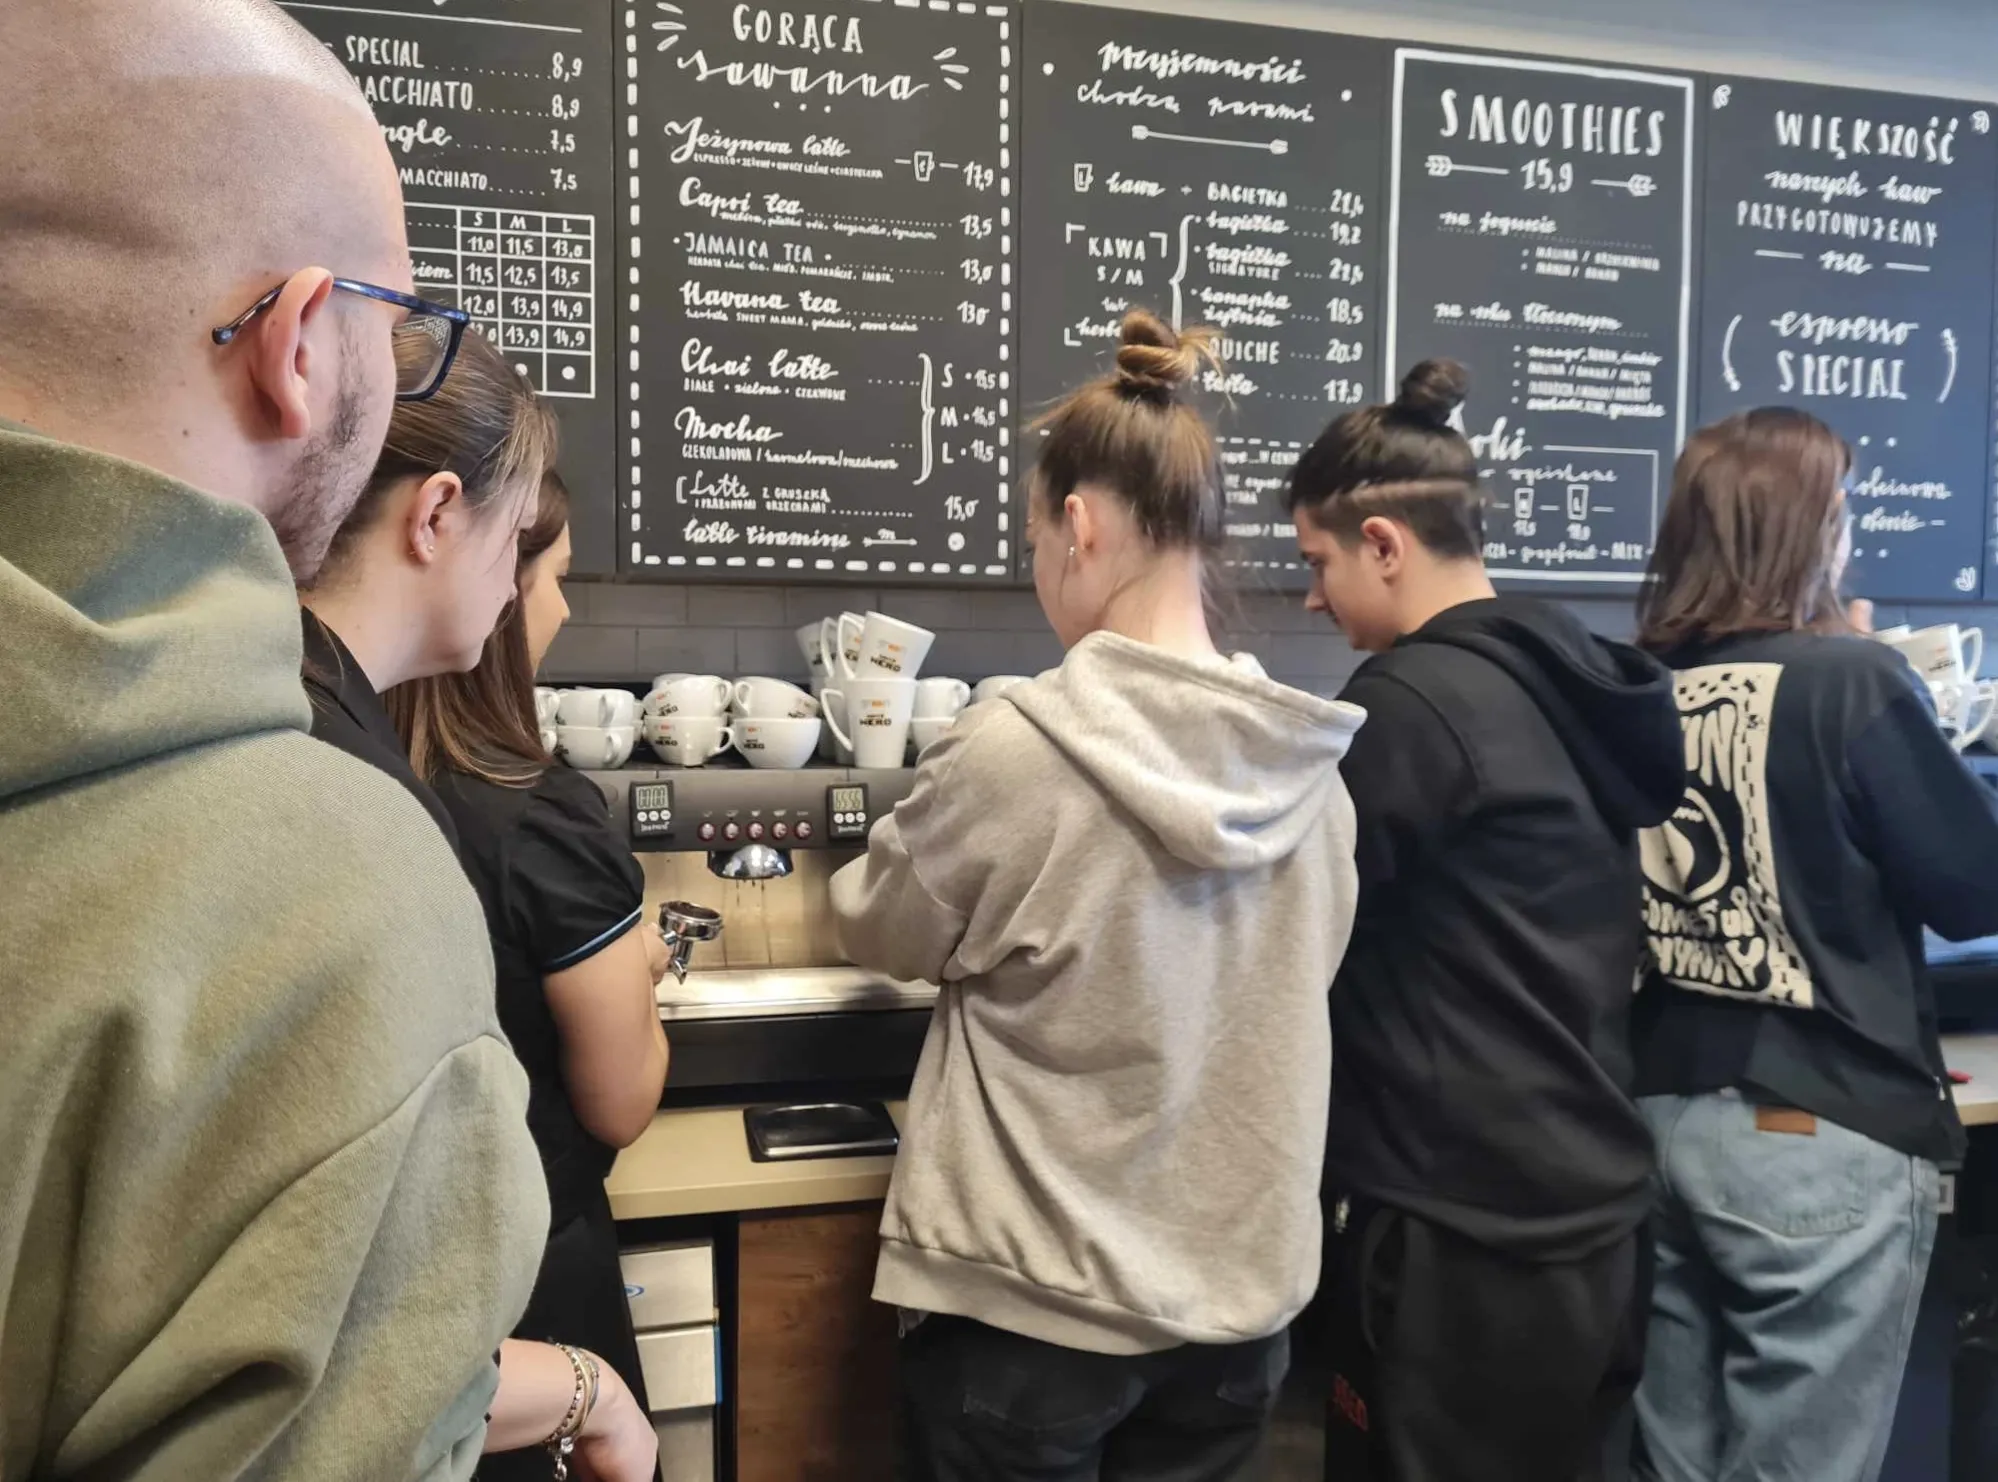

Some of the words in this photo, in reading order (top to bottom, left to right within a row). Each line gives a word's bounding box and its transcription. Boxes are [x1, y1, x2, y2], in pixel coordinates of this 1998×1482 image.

[733, 4, 863, 54] GORĄCA
[346, 35, 424, 69] SPECIAL
[552, 52, 582, 82] 8,9
[552, 95, 580, 120] 8,9
[1440, 88, 1665, 156] SMOOTHIES
[380, 118, 452, 152] ngle
[550, 130, 576, 153] 7,5
[1776, 110, 1958, 164] WIĘKSZOŚĆ
[665, 116, 793, 164] Jeżynowa
[802, 134, 851, 157] latte
[963, 161, 994, 191] 17,9
[400, 167, 487, 190] MACCHIATO
[550, 168, 578, 191] 7,5
[1520, 158, 1573, 193] 15,9
[474, 212, 484, 226] S
[509, 215, 527, 230] M
[562, 219, 572, 233] L
[679, 177, 751, 217] Capri
[763, 193, 804, 215] tea
[960, 213, 993, 239] 13,5
[506, 236, 535, 256] 11,5
[684, 232, 769, 259] JAMAICA
[783, 243, 813, 263] TEA
[1088, 237, 1146, 262] KAWA
[465, 262, 495, 286] 11,5
[504, 265, 537, 287] 12,5
[551, 265, 581, 289] 13,5
[511, 295, 540, 318] 13,9
[551, 298, 583, 320] 14,9
[679, 280, 790, 309] Havana
[799, 289, 841, 314] tea
[1326, 297, 1365, 326] 18,5
[505, 325, 540, 346] 13,9
[552, 327, 586, 347] 14,9
[1769, 310, 1920, 346] espresso
[681, 337, 752, 376] Chai
[768, 348, 840, 381] latte
[1209, 337, 1280, 365] QUICHE
[940, 363, 954, 388] S
[1776, 349, 1908, 400] SPECIAL
[674, 406, 784, 443] Mocha
[940, 405, 958, 428] M
[942, 441, 955, 464] L
